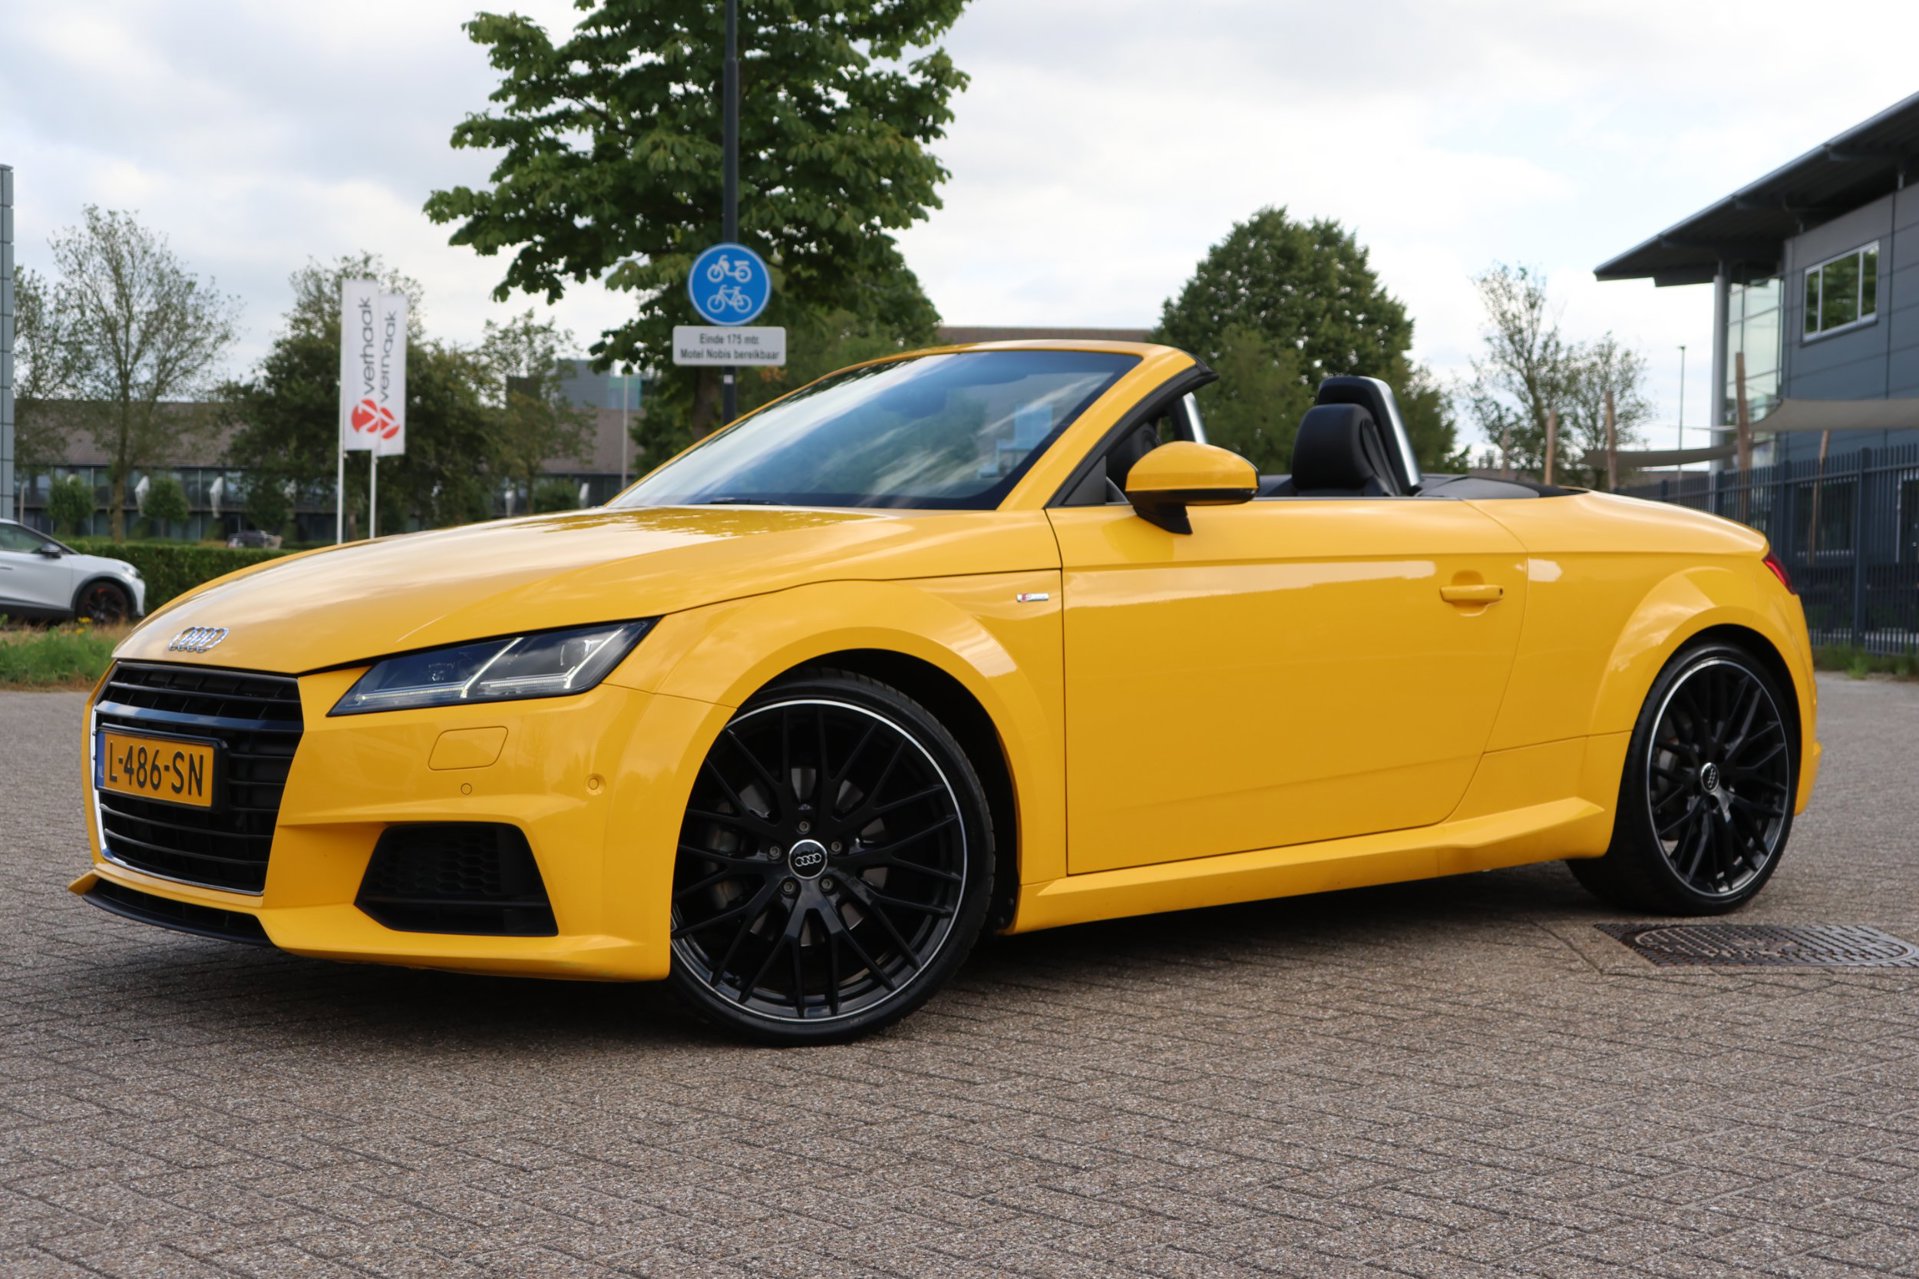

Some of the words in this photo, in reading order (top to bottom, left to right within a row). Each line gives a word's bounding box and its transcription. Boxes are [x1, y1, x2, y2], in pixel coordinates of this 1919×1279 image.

[358, 297, 375, 395] verhaak
[680, 348, 704, 359] Motel
[706, 348, 731, 360] Nobis
[733, 349, 780, 360] bereikbaar
[699, 333, 724, 344] Einde
[727, 334, 742, 344] 175
[109, 741, 204, 797] L-486-SN
